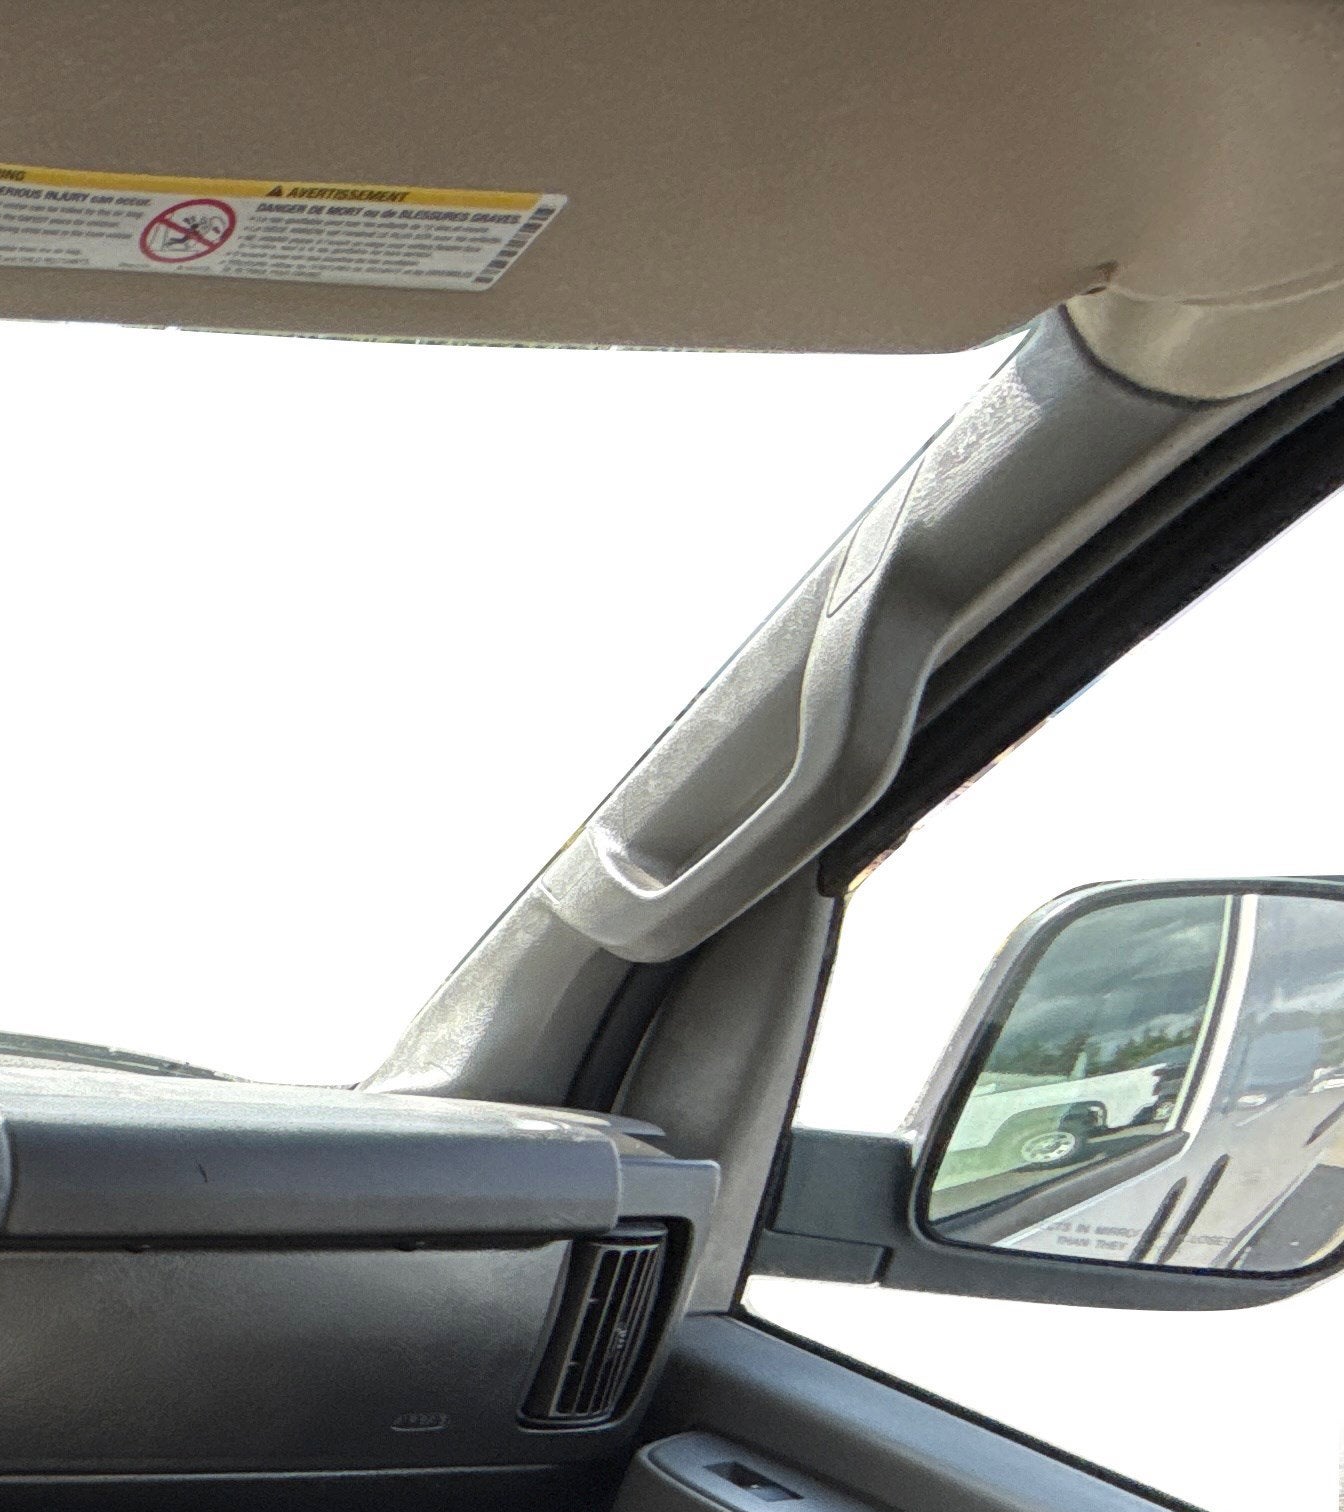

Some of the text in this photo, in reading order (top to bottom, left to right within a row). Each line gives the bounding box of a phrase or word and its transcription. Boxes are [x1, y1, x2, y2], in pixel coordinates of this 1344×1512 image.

[43, 190, 91, 203] INJURY
[288, 186, 410, 203] AVERTISSEMENT
[255, 203, 308, 214] DANGER
[306, 205, 327, 215] DE
[326, 206, 366, 216] MORT
[398, 210, 471, 222] BLESSURES
